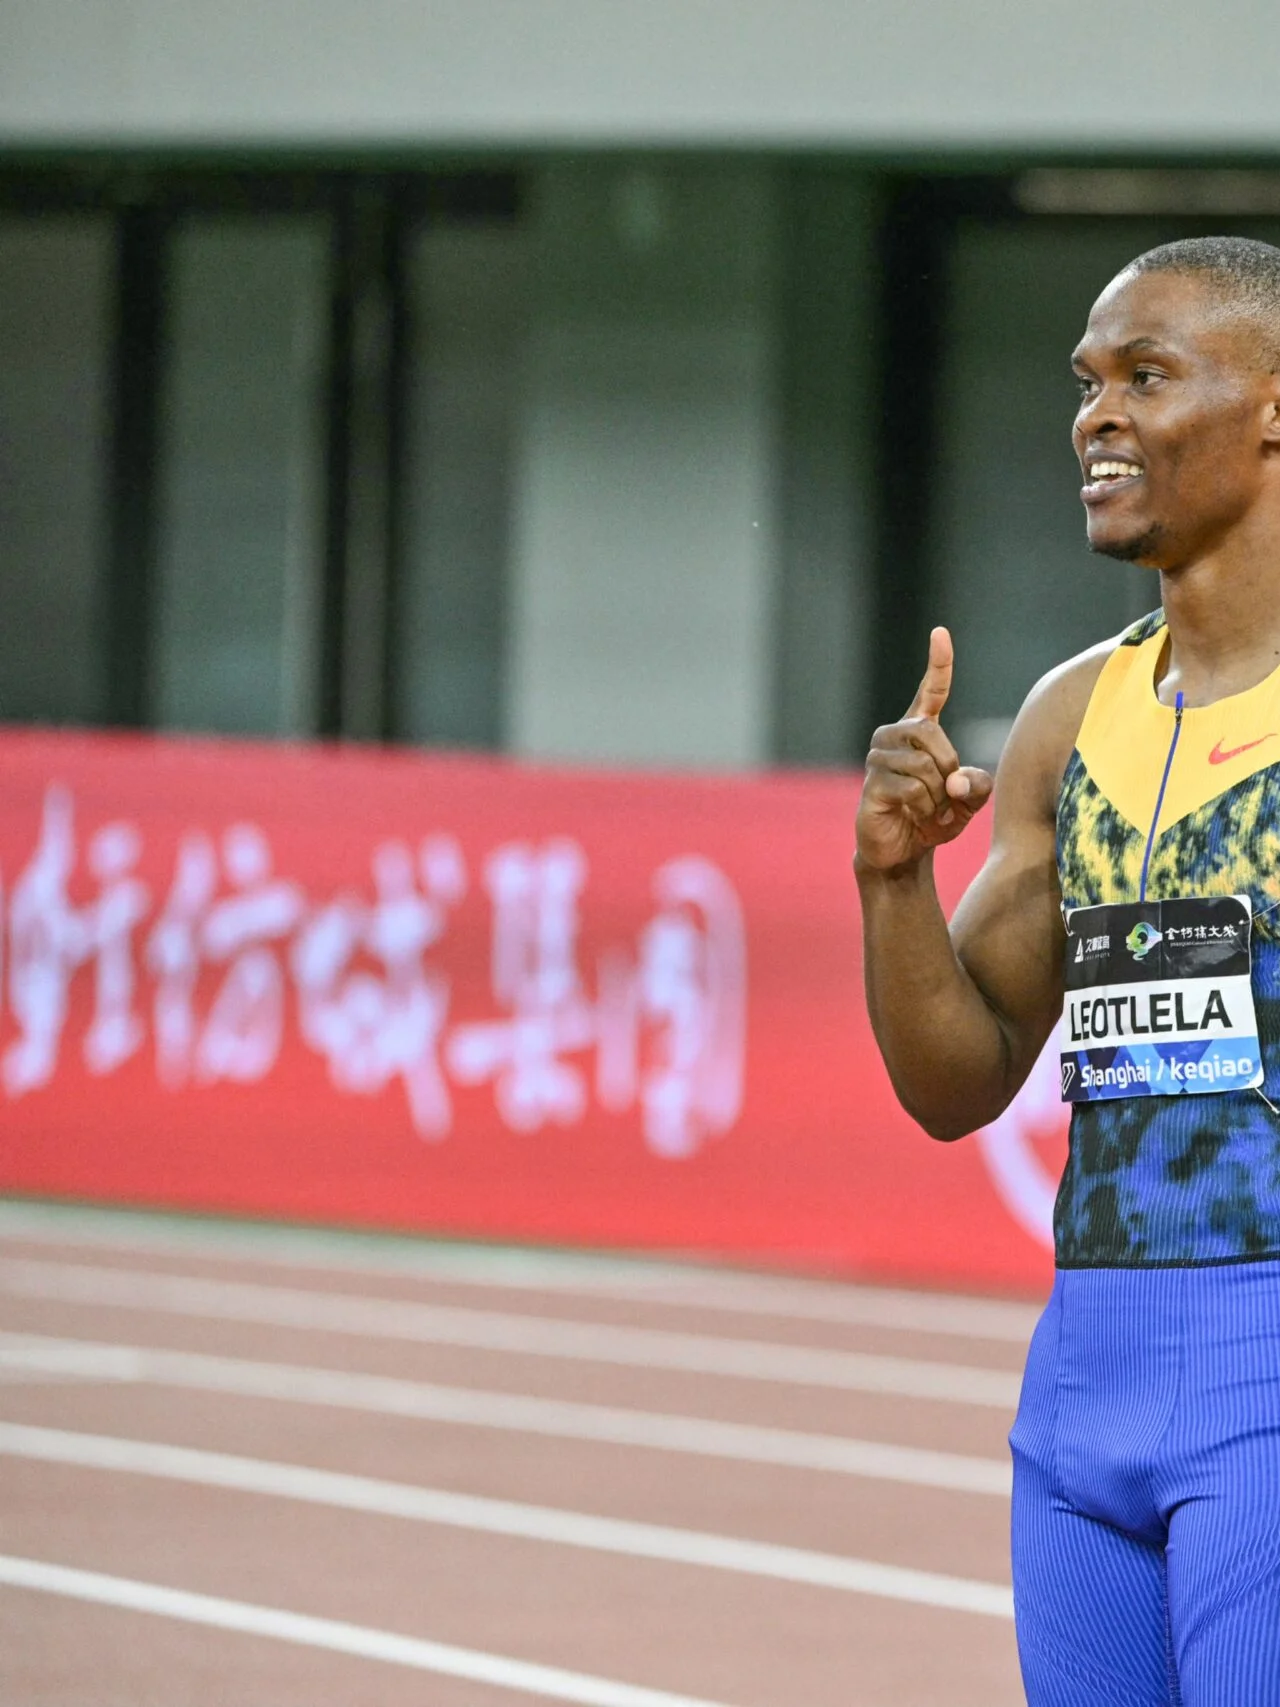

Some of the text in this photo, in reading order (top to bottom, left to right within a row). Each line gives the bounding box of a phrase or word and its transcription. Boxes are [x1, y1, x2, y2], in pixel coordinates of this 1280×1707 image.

[1071, 990, 1233, 1042] LEOTLELA
[1080, 1060, 1150, 1088] Shanghai
[1170, 1055, 1253, 1083] keqiao
